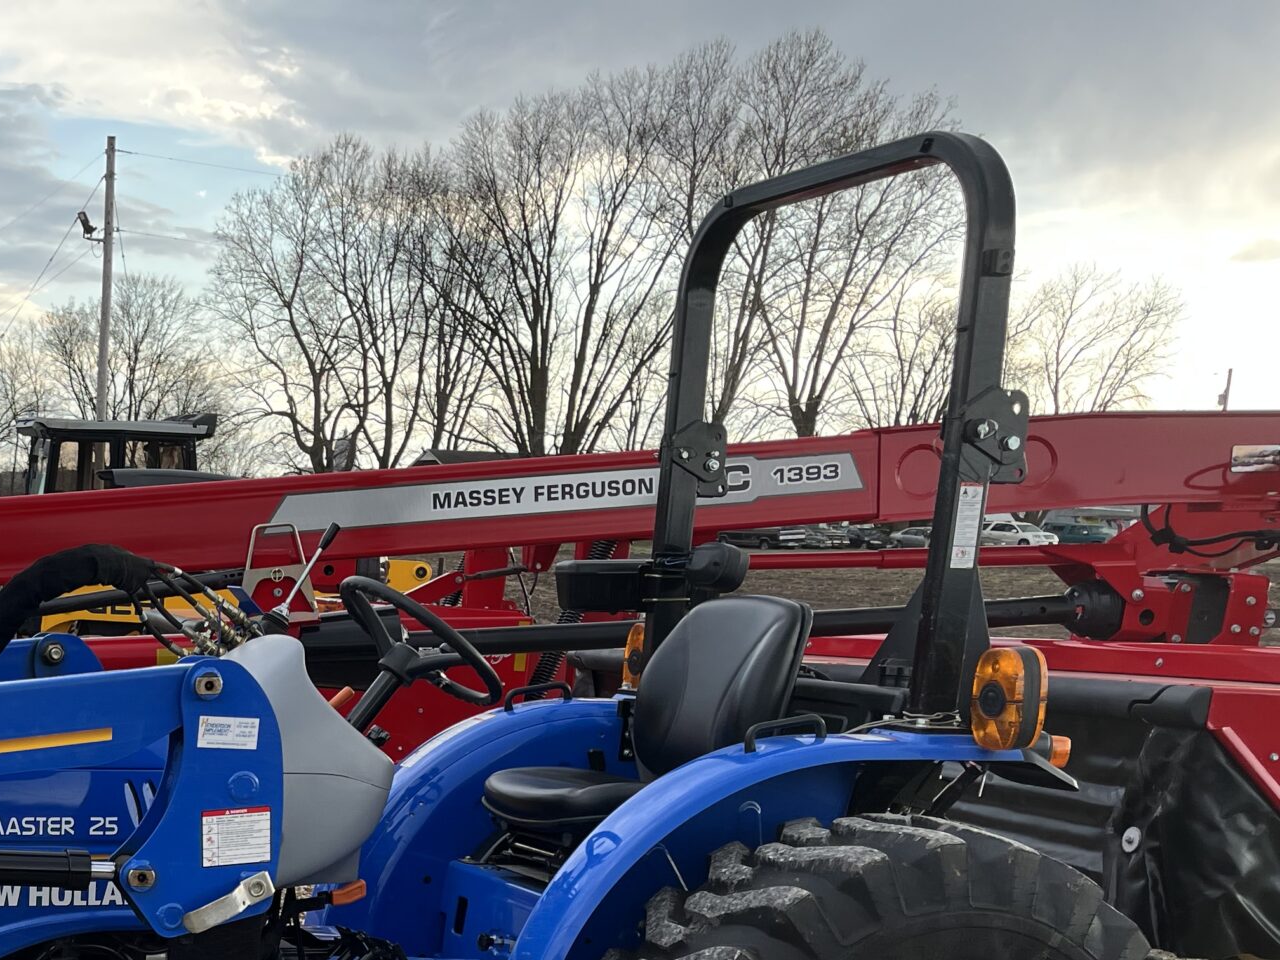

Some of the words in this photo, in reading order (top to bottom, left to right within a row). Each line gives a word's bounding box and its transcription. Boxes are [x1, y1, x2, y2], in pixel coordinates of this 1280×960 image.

[773, 463, 839, 483] 1393
[432, 486, 526, 510] MASSEY
[533, 477, 654, 502] FERGUSON
[89, 816, 119, 836] 25
[28, 880, 129, 907] HOLLA
